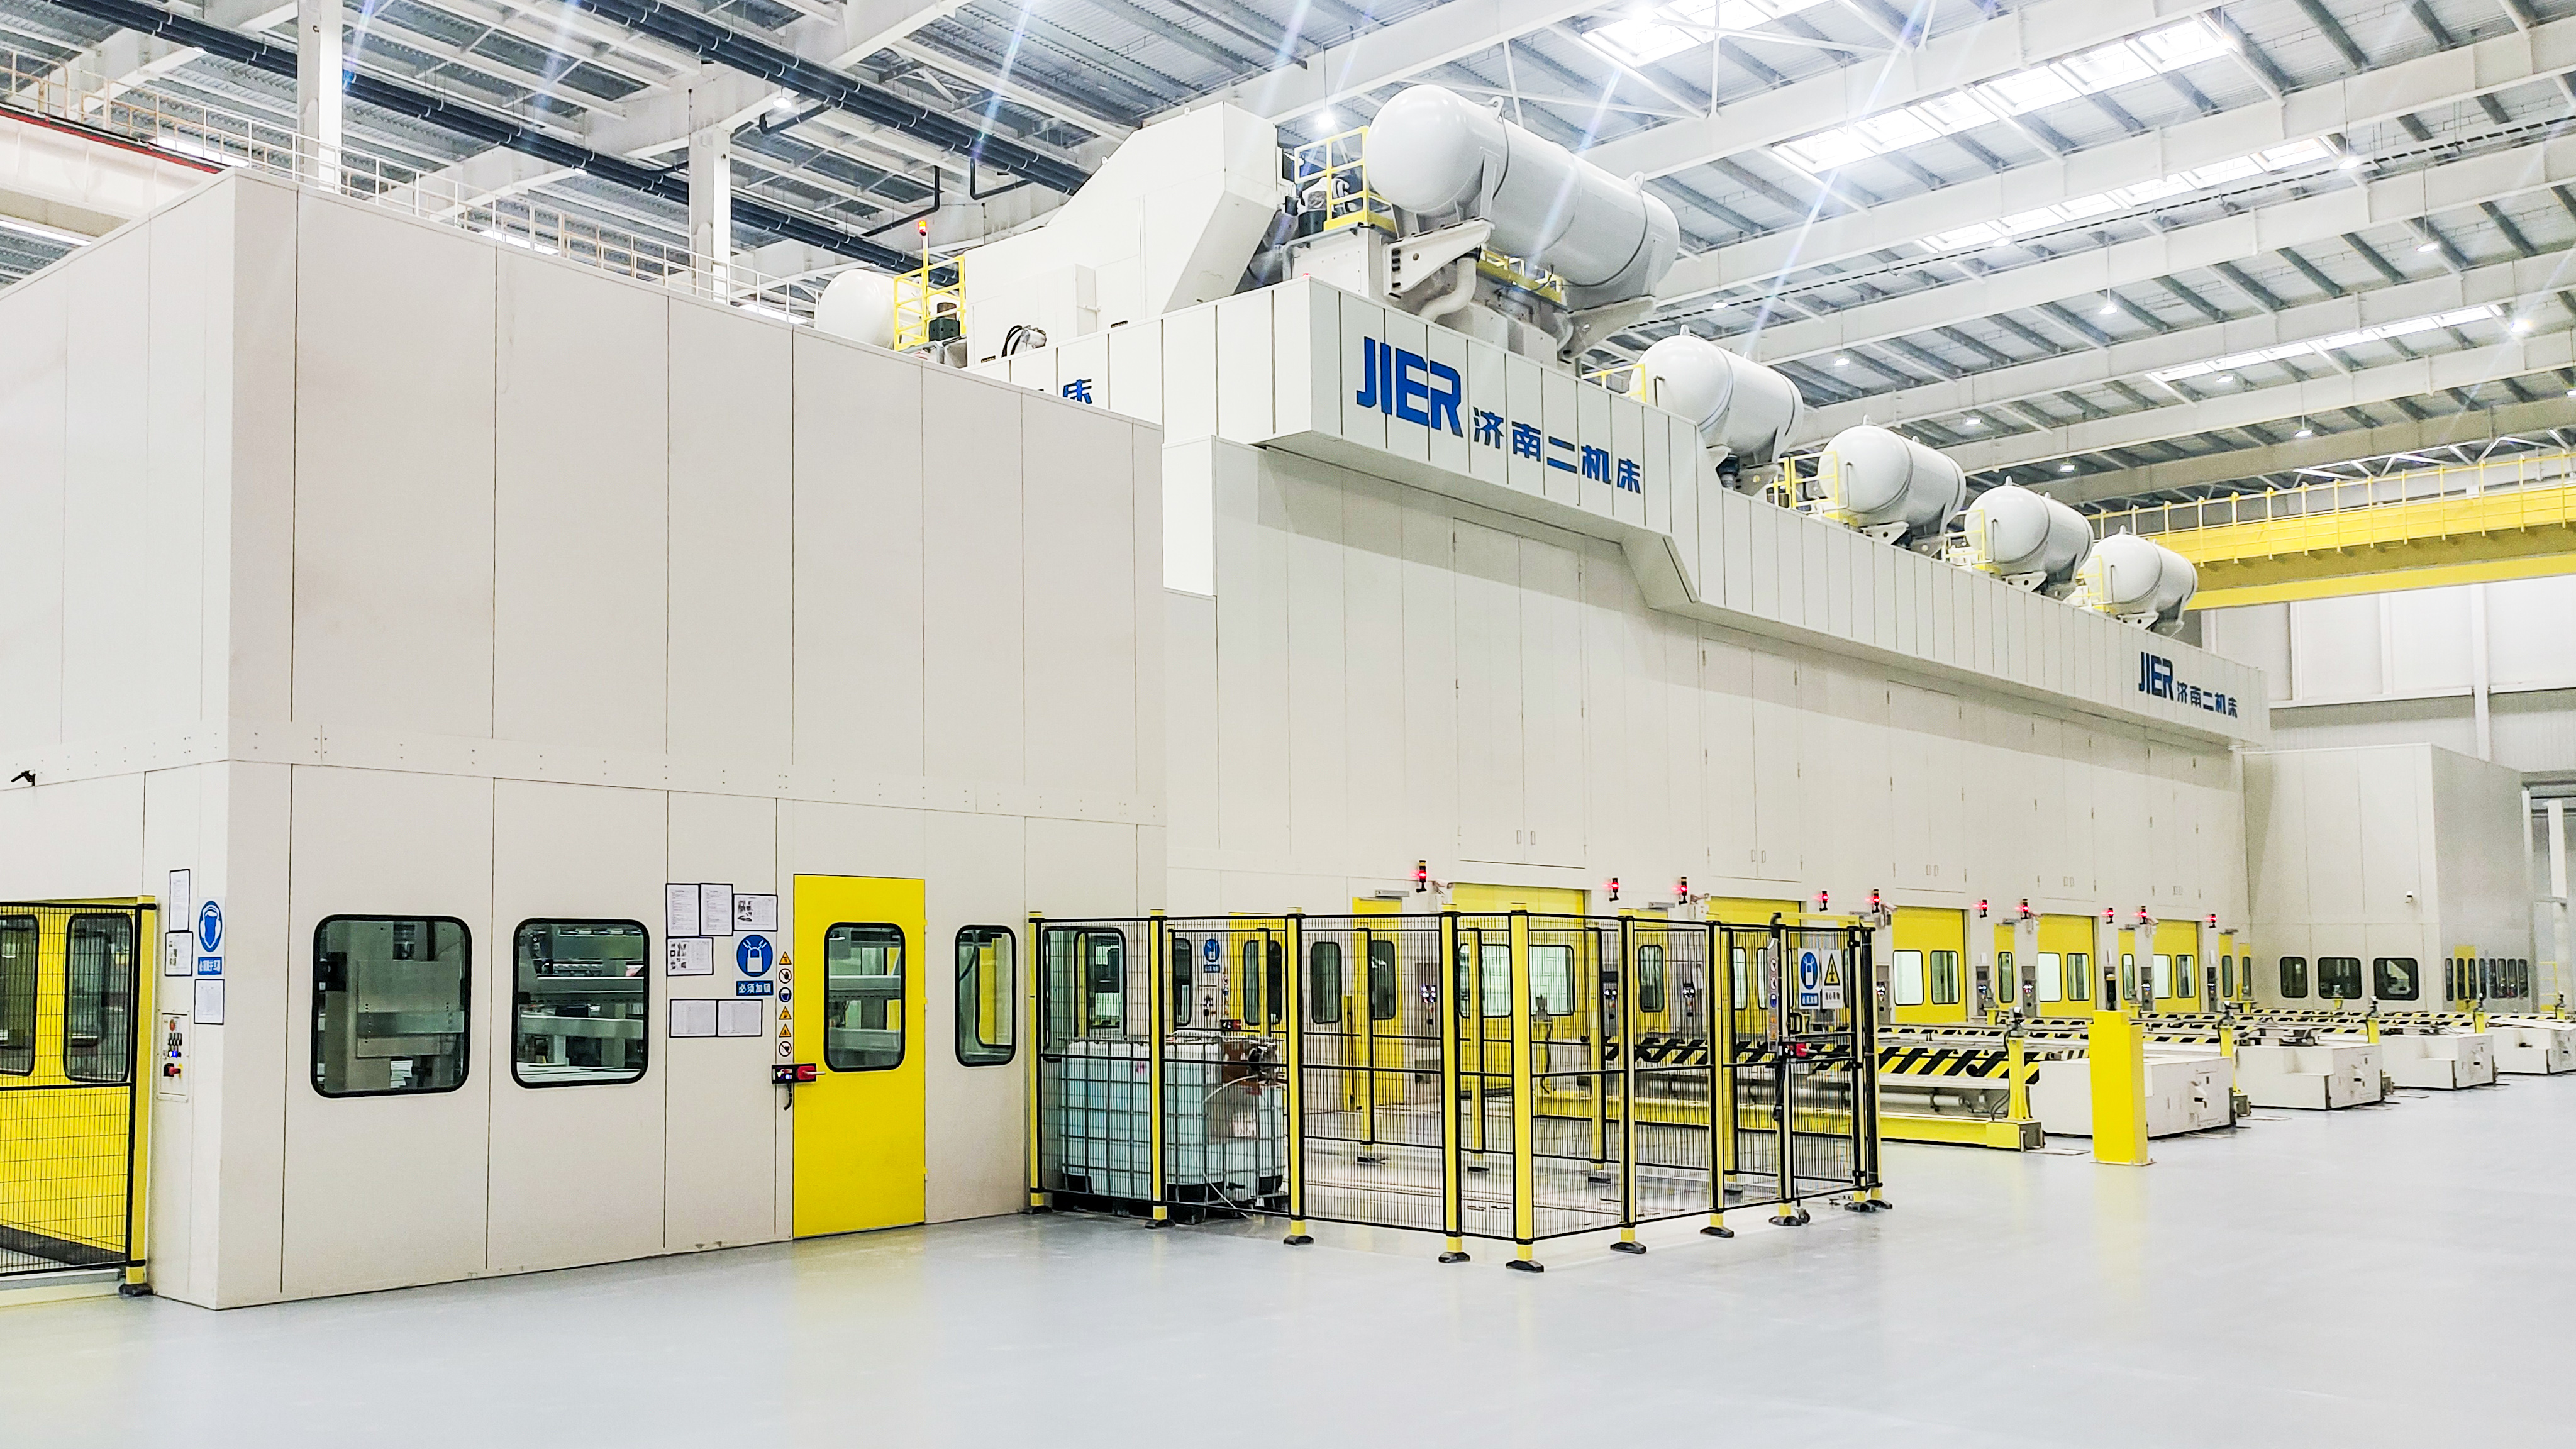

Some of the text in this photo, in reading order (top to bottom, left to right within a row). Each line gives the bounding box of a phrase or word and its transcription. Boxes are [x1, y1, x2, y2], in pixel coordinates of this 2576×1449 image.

[1356, 336, 1640, 494] JIER 济南二机床
[2138, 651, 2238, 718] JIER 济南二机床
